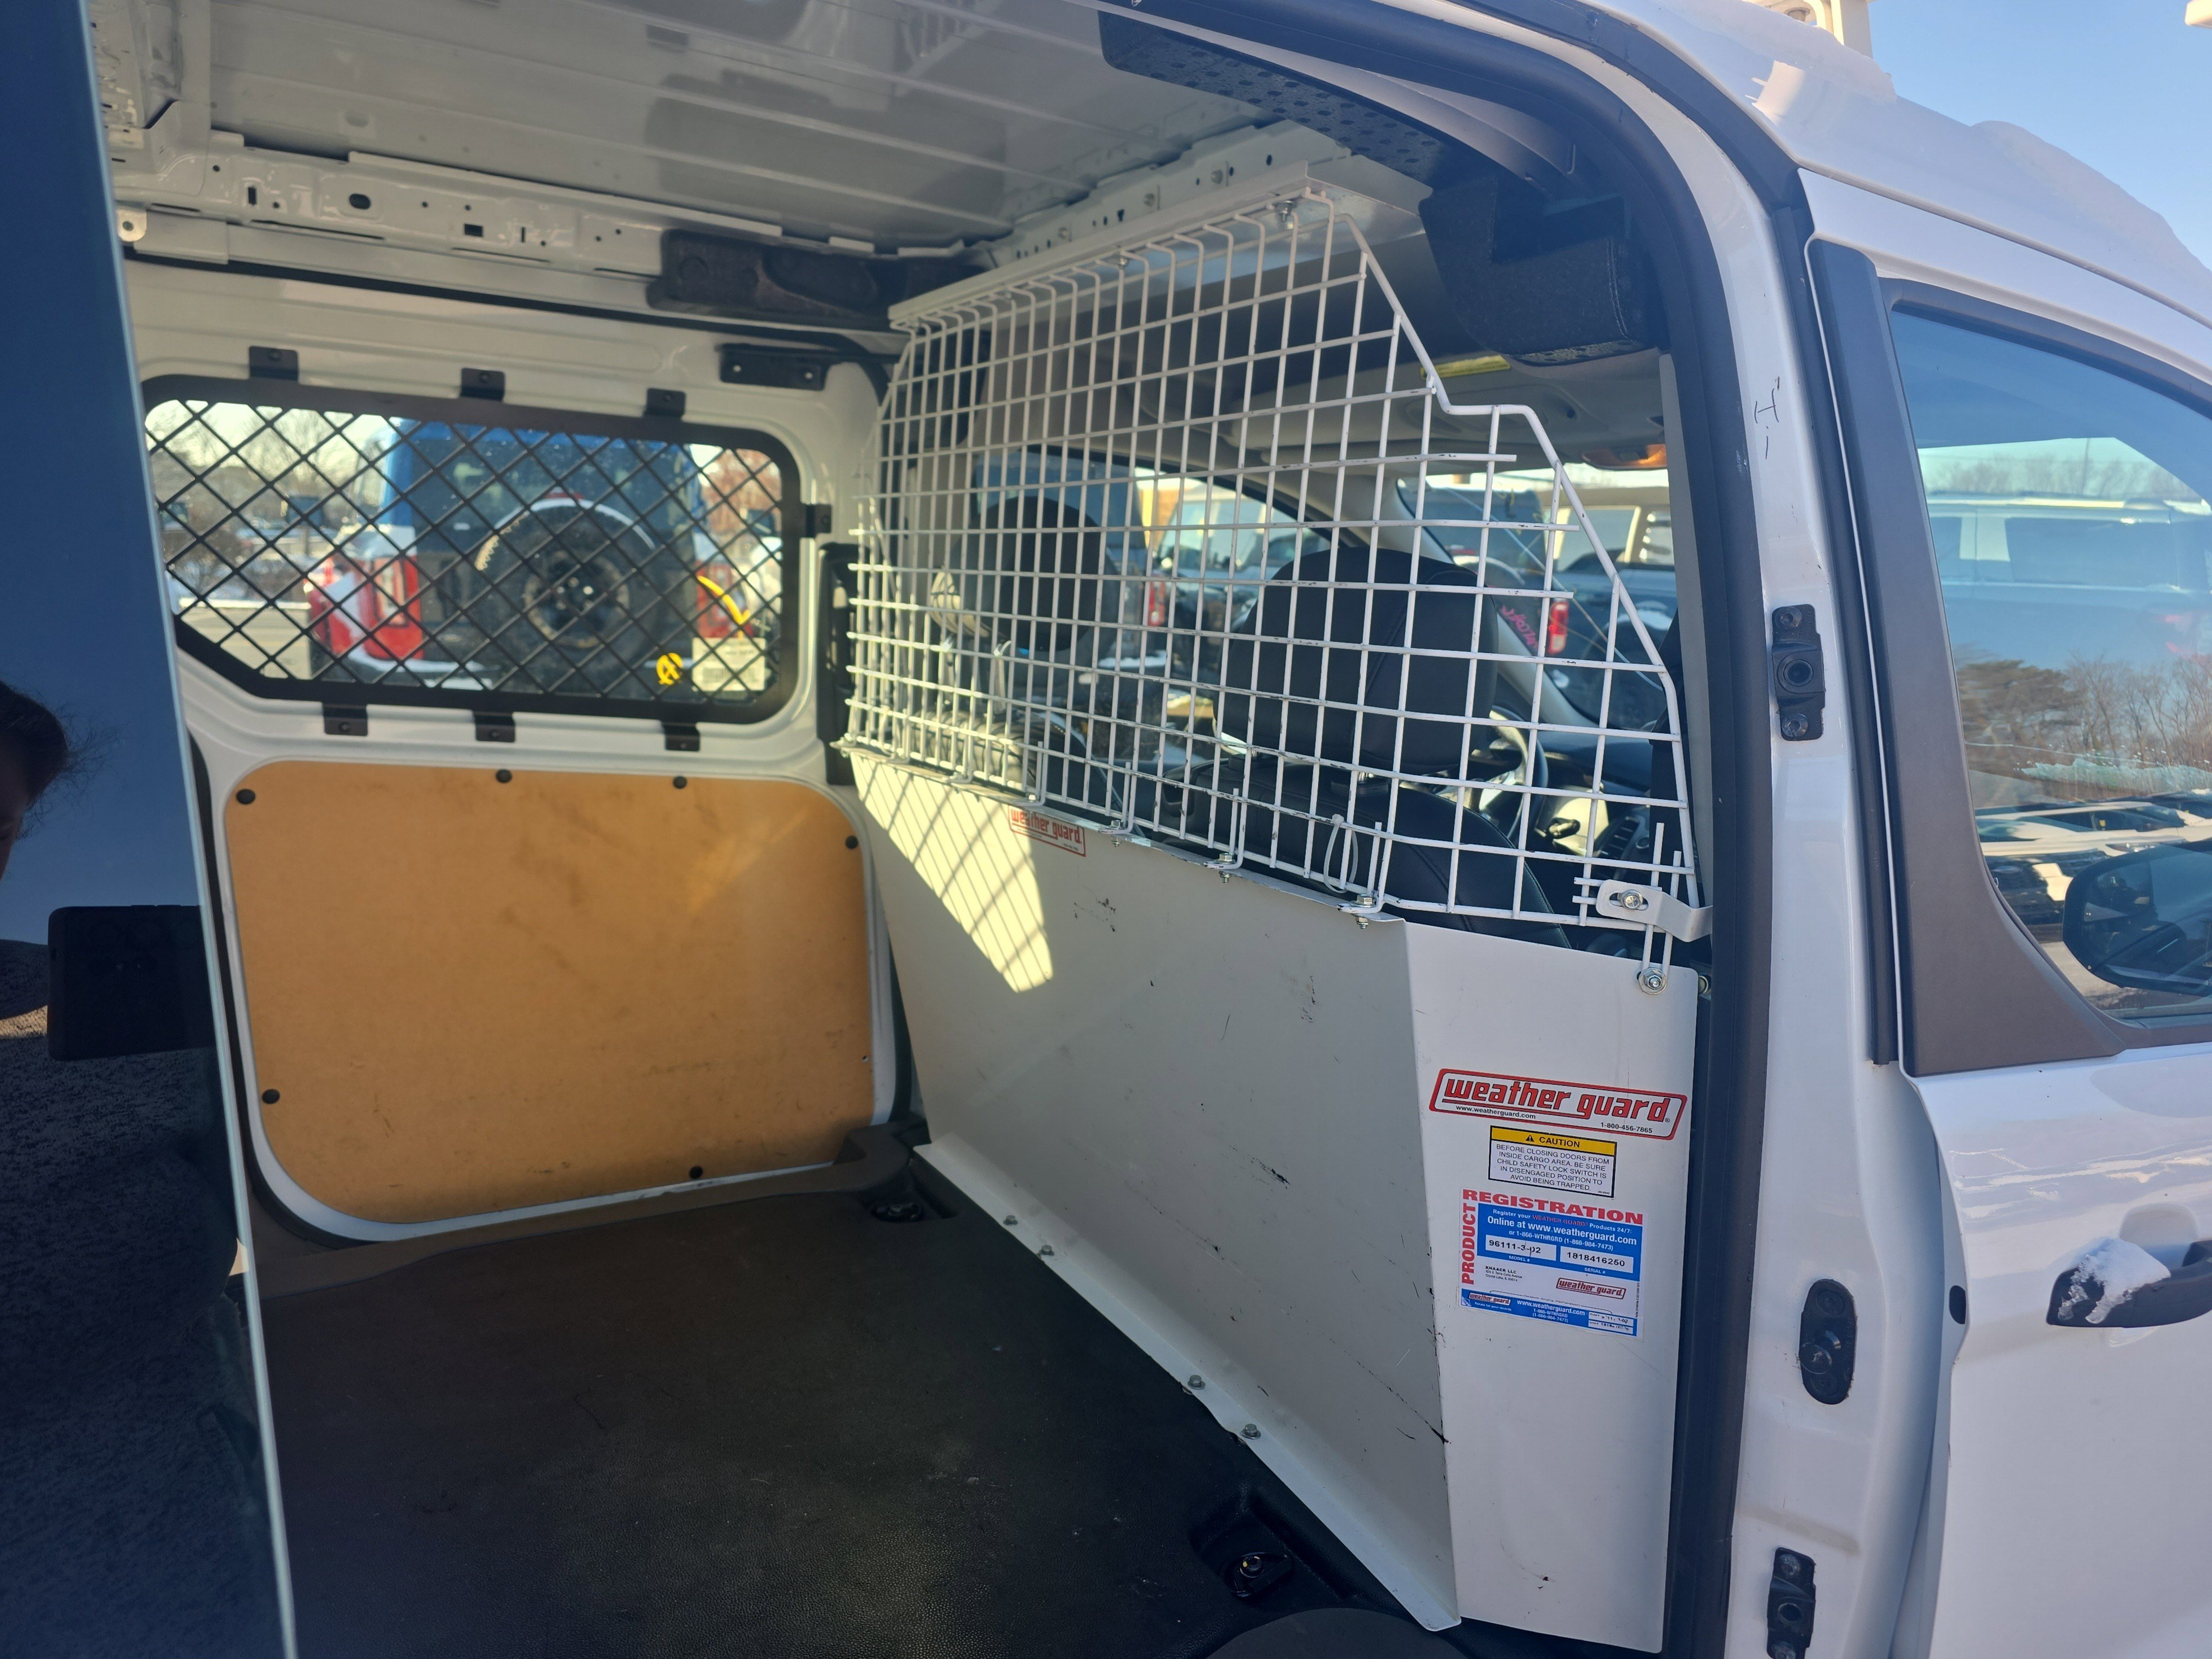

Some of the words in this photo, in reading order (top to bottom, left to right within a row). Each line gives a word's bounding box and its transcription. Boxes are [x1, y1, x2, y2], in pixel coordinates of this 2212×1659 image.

[1444, 1079, 1572, 1110] weather
[1456, 1105, 1536, 1120] www.weatherguard.com
[1600, 1122, 1652, 1134] 1-800-456-7865
[1539, 1136, 1580, 1148] CAUTION
[1496, 1143, 1525, 1153] BEFORE
[1527, 1148, 1558, 1158] CLOSING
[1560, 1153, 1586, 1161] DOORS
[1588, 1156, 1609, 1165] FROM
[1499, 1151, 1522, 1159] INSIDE
[1524, 1155, 1549, 1163] CARGO
[1497, 1158, 1518, 1166] CHILD
[1520, 1161, 1547, 1170] SAFETY
[1548, 1165, 1568, 1173] LOCK
[1570, 1168, 1598, 1178] SWITCH
[1509, 1167, 1555, 1178] DISENGAGED
[1557, 1174, 1591, 1184] POSITION
[1510, 1174, 1531, 1182] AVOID
[1533, 1178, 1555, 1186] BEING
[1463, 1189, 1643, 1225] REGISTRATION
[1493, 1208, 1516, 1217] Register
[1590, 1223, 1616, 1231] Products
[1488, 1216, 1515, 1227] Online
[1528, 1222, 1637, 1245] www.weatherguard.com
[1462, 1203, 1476, 1285] PRODUCT
[1489, 1239, 1541, 1253] 96111-3-02
[1564, 1238, 1613, 1251] (1-866-984-7473)
[1567, 1252, 1625, 1266] 1818416250
[1559, 1280, 1595, 1291] weather
[1516, 1300, 1585, 1316] www.weatherguard.com
